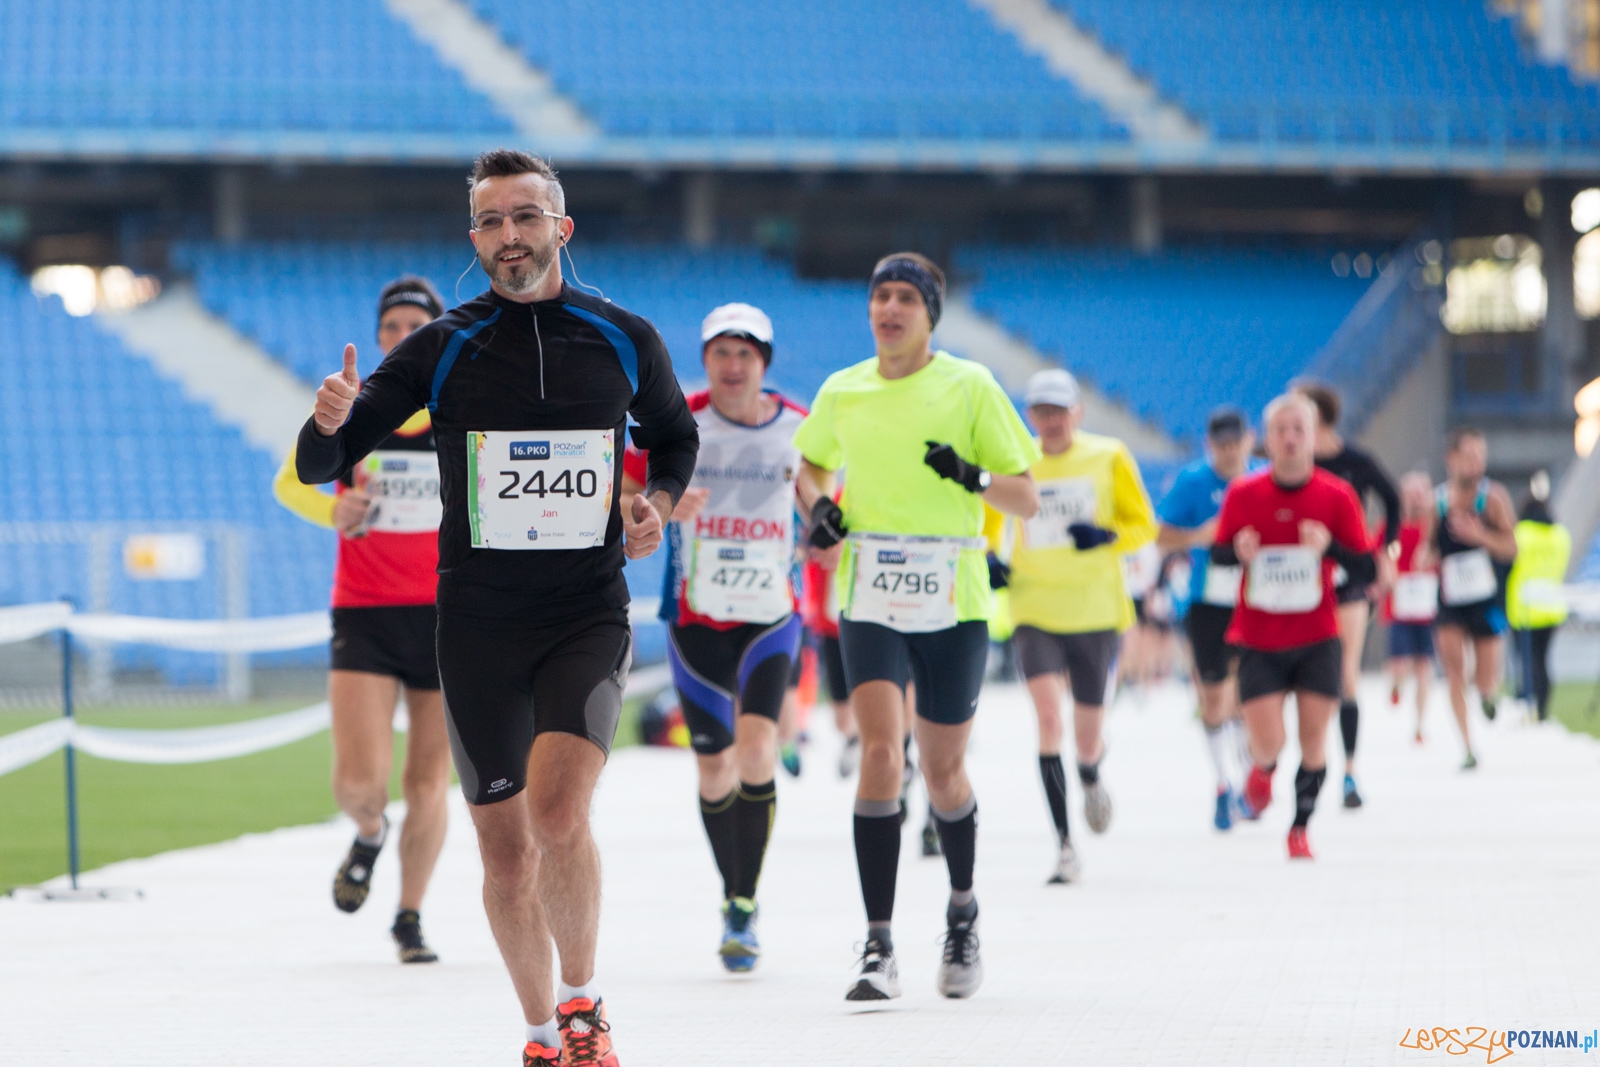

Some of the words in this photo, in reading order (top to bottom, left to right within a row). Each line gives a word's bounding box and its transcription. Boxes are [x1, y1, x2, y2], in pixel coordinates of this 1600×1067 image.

[553, 449, 586, 457] maraton
[498, 469, 597, 499] 2440
[541, 509, 558, 518] Jan
[695, 515, 785, 541] HERON
[711, 567, 774, 590] 4772
[872, 571, 939, 595] 4796
